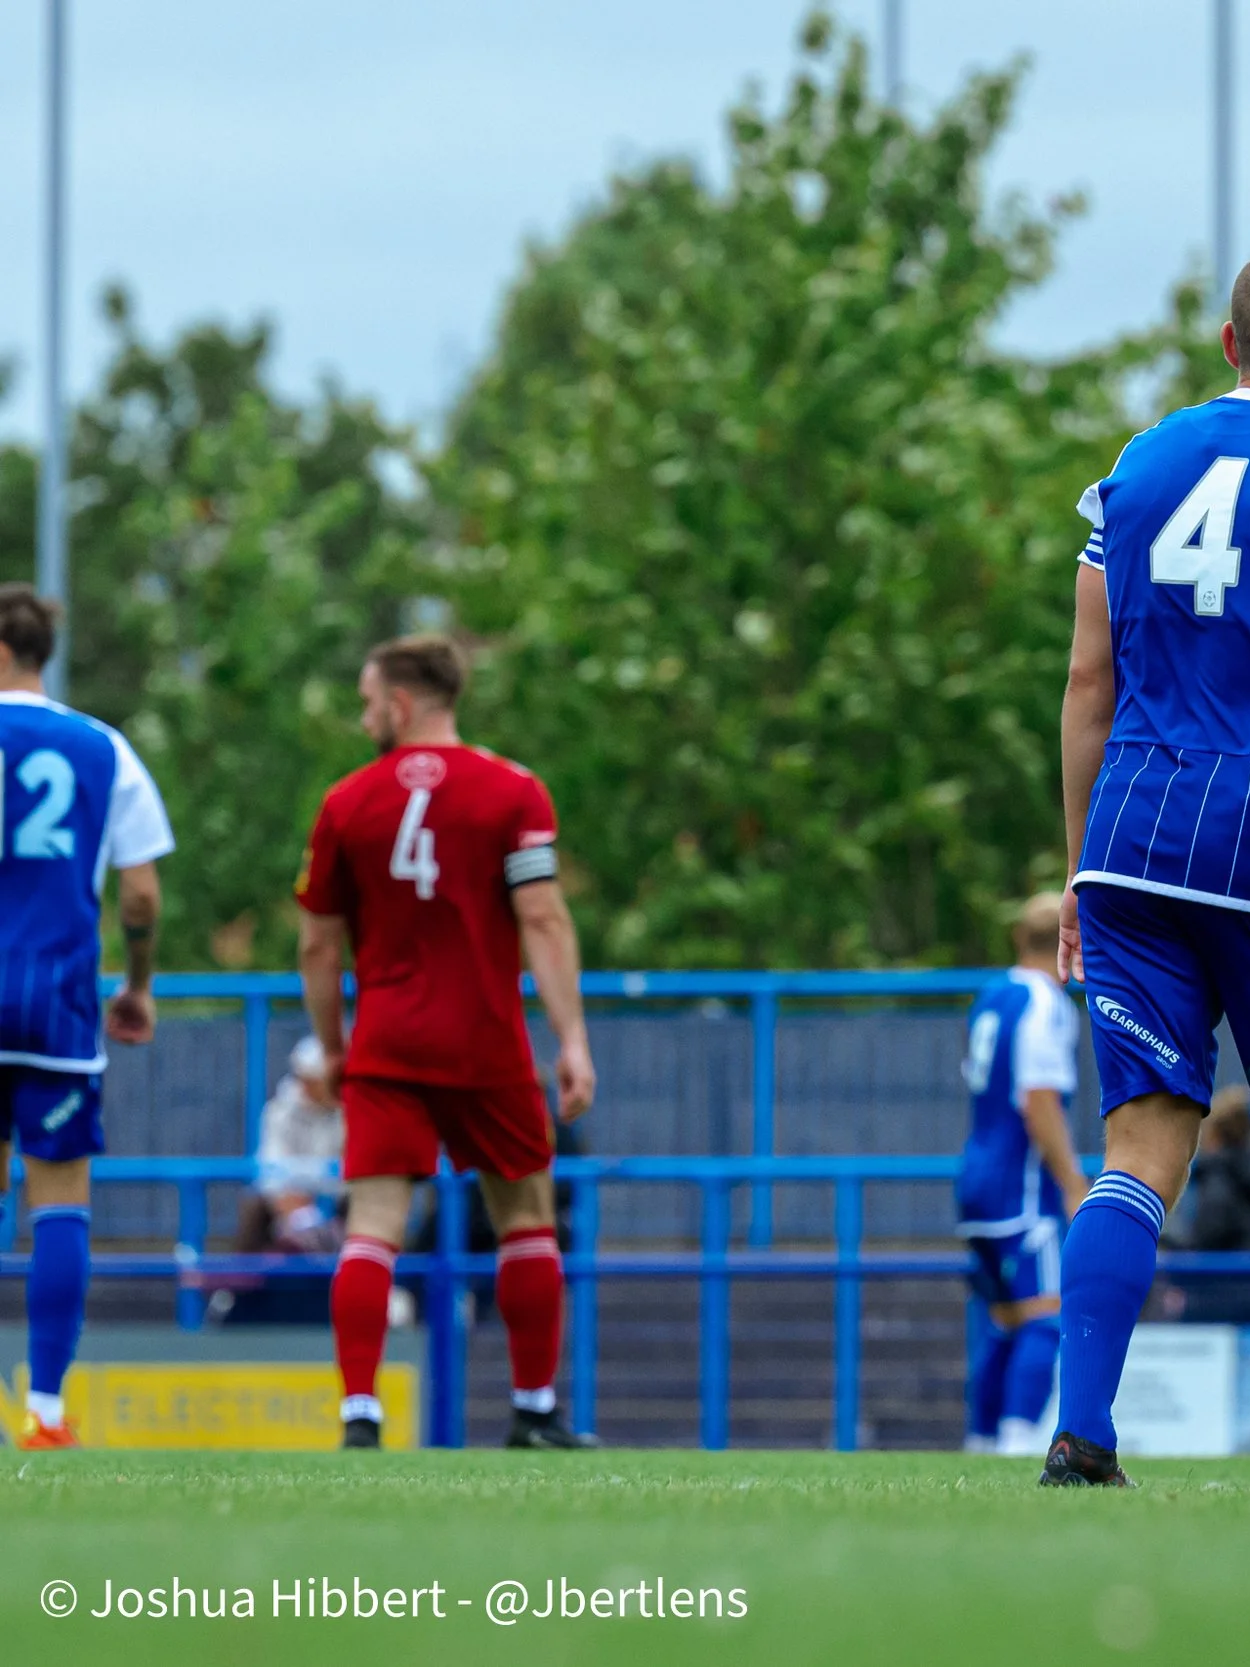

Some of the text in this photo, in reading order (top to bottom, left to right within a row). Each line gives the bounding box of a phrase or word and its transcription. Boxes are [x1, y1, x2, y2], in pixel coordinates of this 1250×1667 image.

[1150, 456, 1250, 617] 4
[0, 748, 76, 859] 2
[389, 787, 440, 900] 4
[1110, 1010, 1180, 1064] BARNSHAWS
